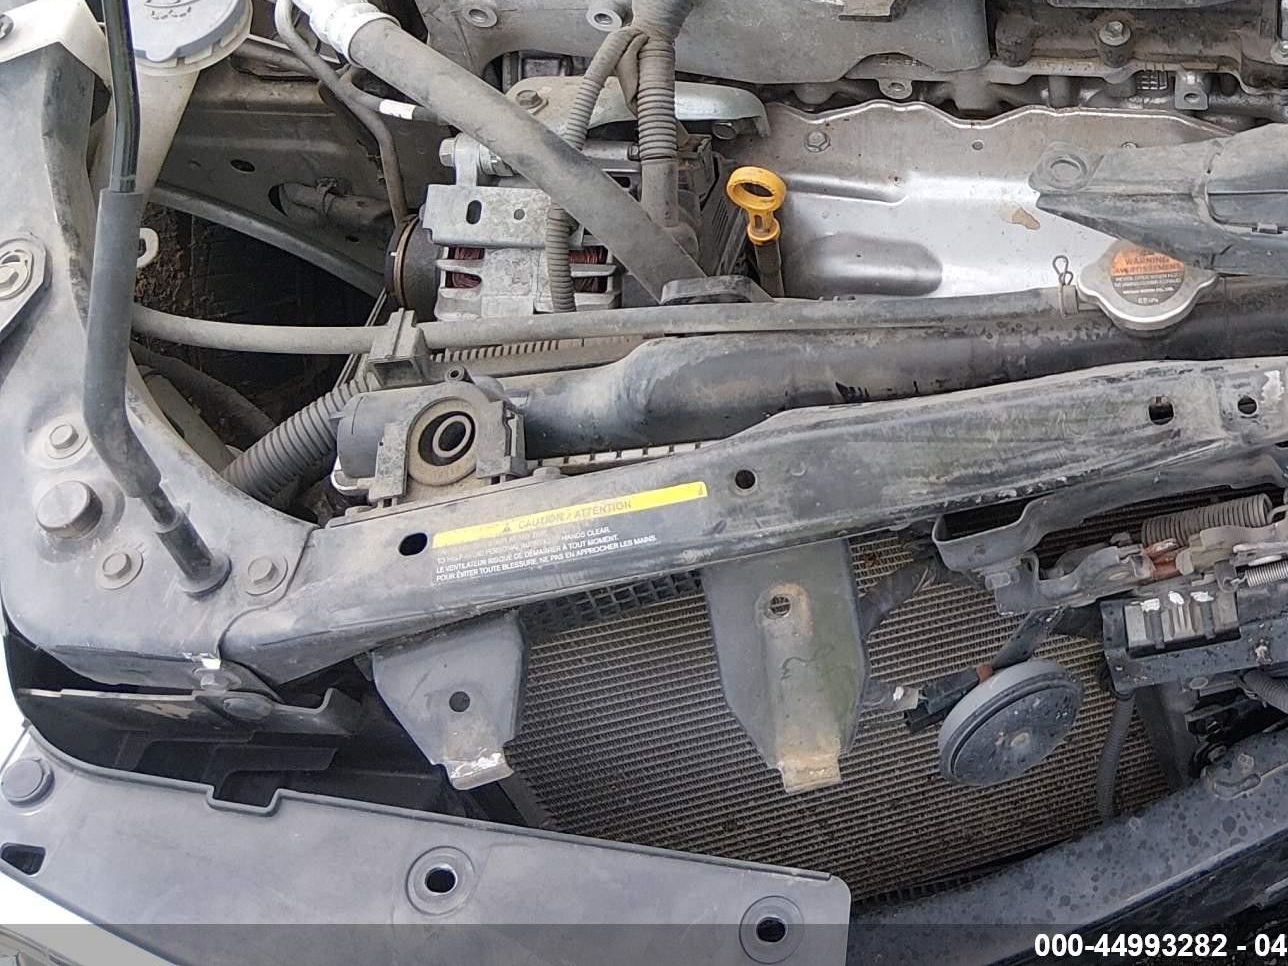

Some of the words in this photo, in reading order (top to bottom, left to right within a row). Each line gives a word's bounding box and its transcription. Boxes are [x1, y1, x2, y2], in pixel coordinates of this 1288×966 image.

[1125, 255, 1169, 265] WARNING
[518, 512, 565, 530] CAUTION
[573, 500, 632, 519] ATTENTION
